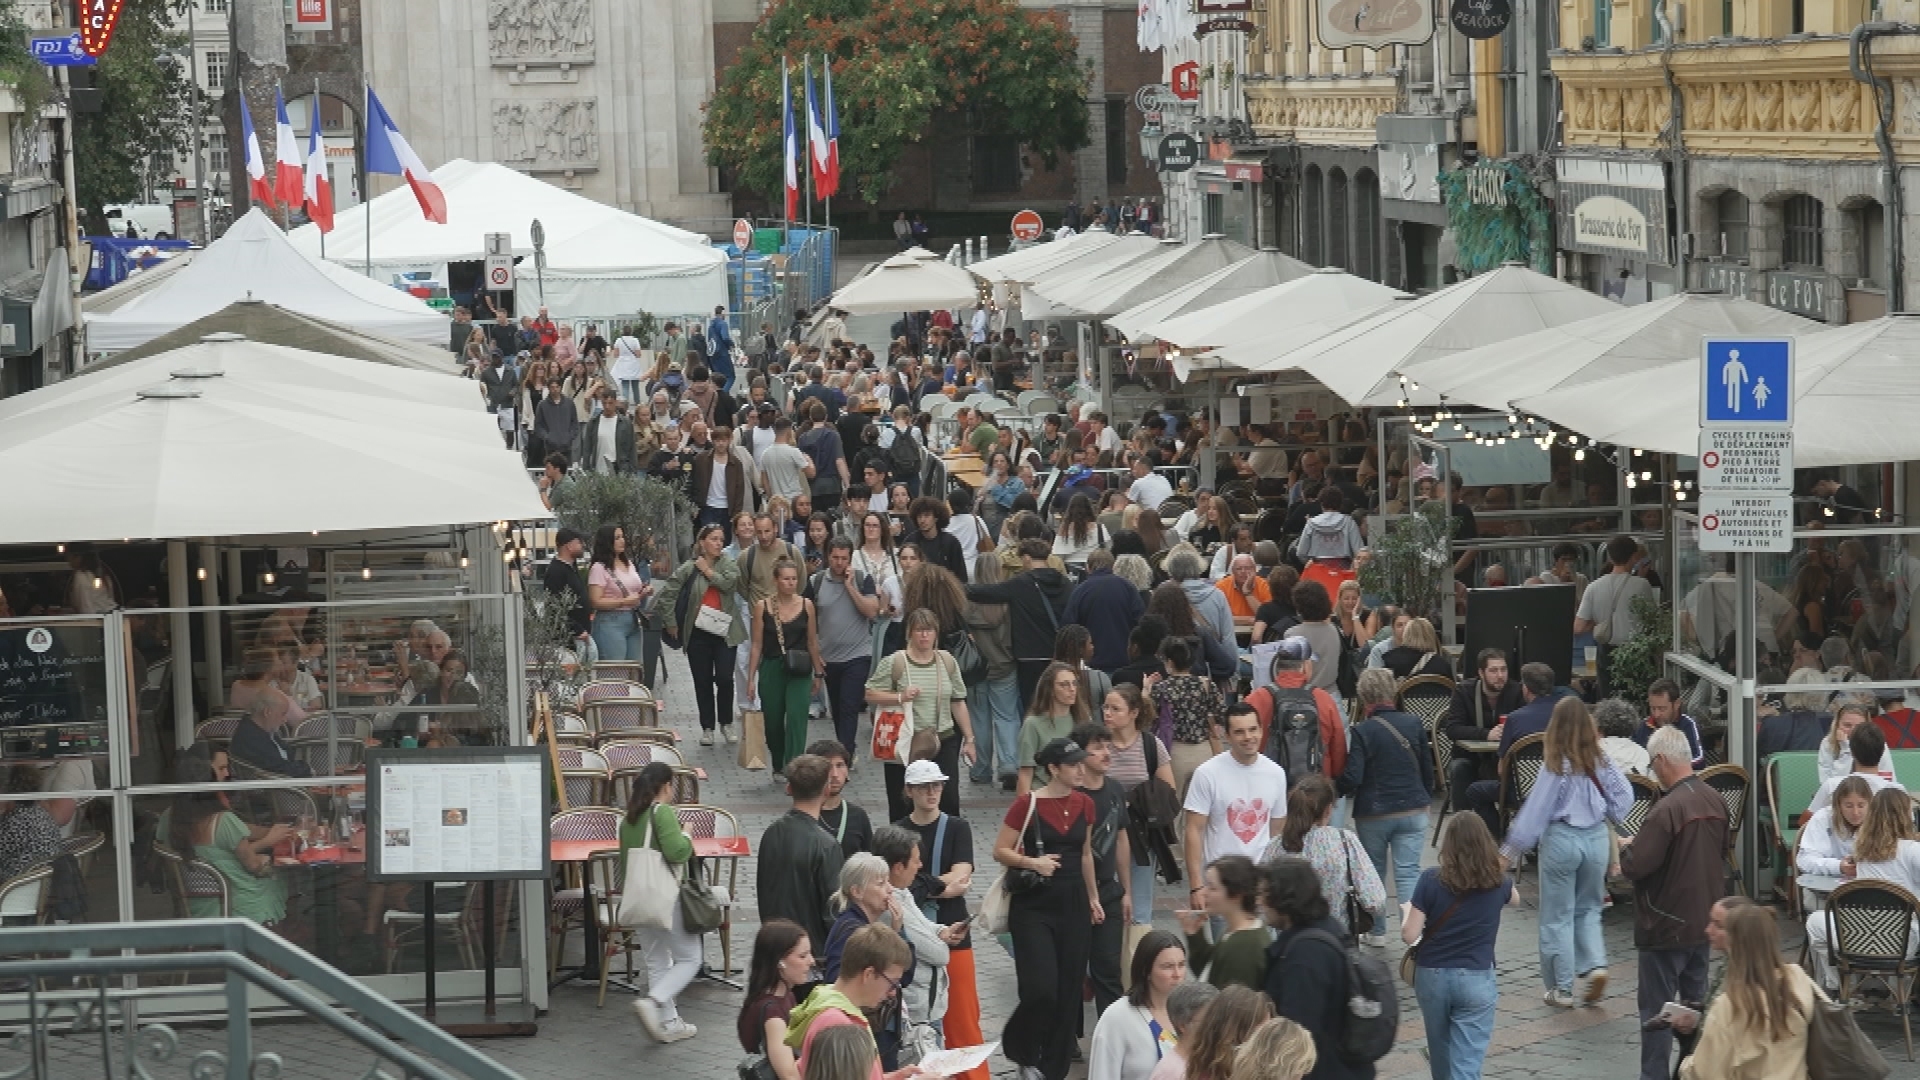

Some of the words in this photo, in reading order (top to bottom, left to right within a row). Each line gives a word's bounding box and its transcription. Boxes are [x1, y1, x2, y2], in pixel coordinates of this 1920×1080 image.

[1455, 11, 1505, 29] PEACOCK
[35, 41, 62, 54] FDJ
[1467, 168, 1508, 206] PEACOCK
[1579, 212, 1615, 237] Brasserie
[1616, 216, 1627, 239] de
[1628, 217, 1641, 247] Foy
[1769, 277, 1787, 306] de
[1793, 279, 1823, 313] FOY
[1712, 431, 1744, 439] CYCLES
[1745, 431, 1757, 439] ET
[1758, 431, 1792, 439] ENGINS
[1713, 441, 1725, 449] DE
[1727, 439, 1790, 449] DÉPLACEMENT
[1722, 449, 1781, 457] PERSONNELS
[1721, 458, 1742, 467] PIED
[1753, 458, 1781, 467] TERRE
[1723, 467, 1779, 475] OBLIGATOIRE
[1721, 475, 1732, 483] DE
[1735, 475, 1750, 483] 11H
[1731, 499, 1772, 507] INTERDIT
[1715, 509, 1738, 517] SAUF
[1740, 507, 1789, 517] VÉHICULES
[1721, 518, 1769, 527] AUTORISÉS
[1771, 519, 1782, 527] ET
[1718, 529, 1770, 537] LIVRAISONS
[1772, 529, 1784, 538] DE
[1755, 539, 1770, 547] 11H
